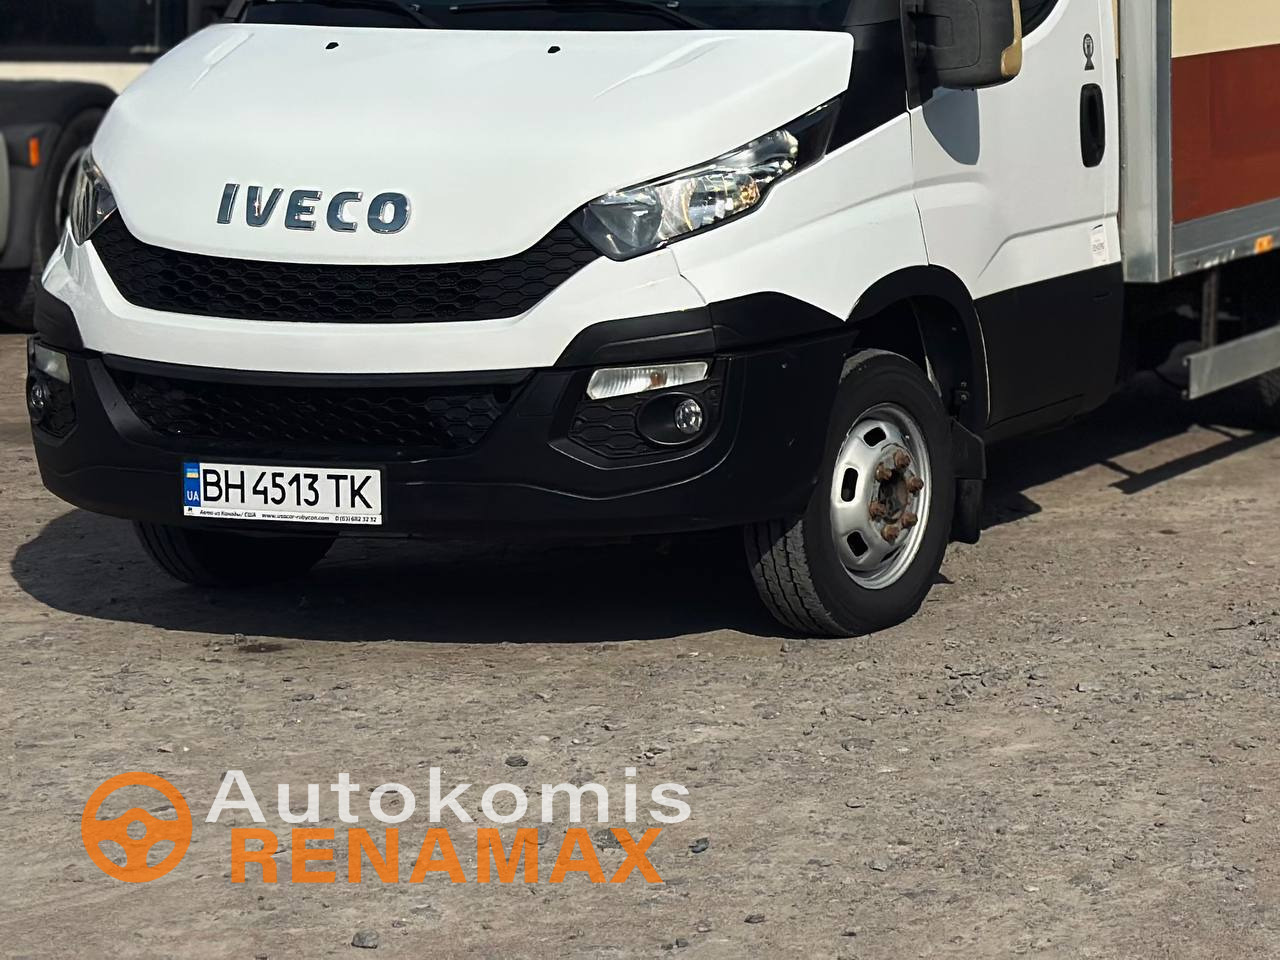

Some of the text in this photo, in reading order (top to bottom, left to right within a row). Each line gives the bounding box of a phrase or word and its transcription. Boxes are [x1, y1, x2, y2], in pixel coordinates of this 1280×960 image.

[216, 183, 412, 235] IVECO
[186, 490, 200, 502] UA
[202, 468, 373, 509] BH 4513 TK
